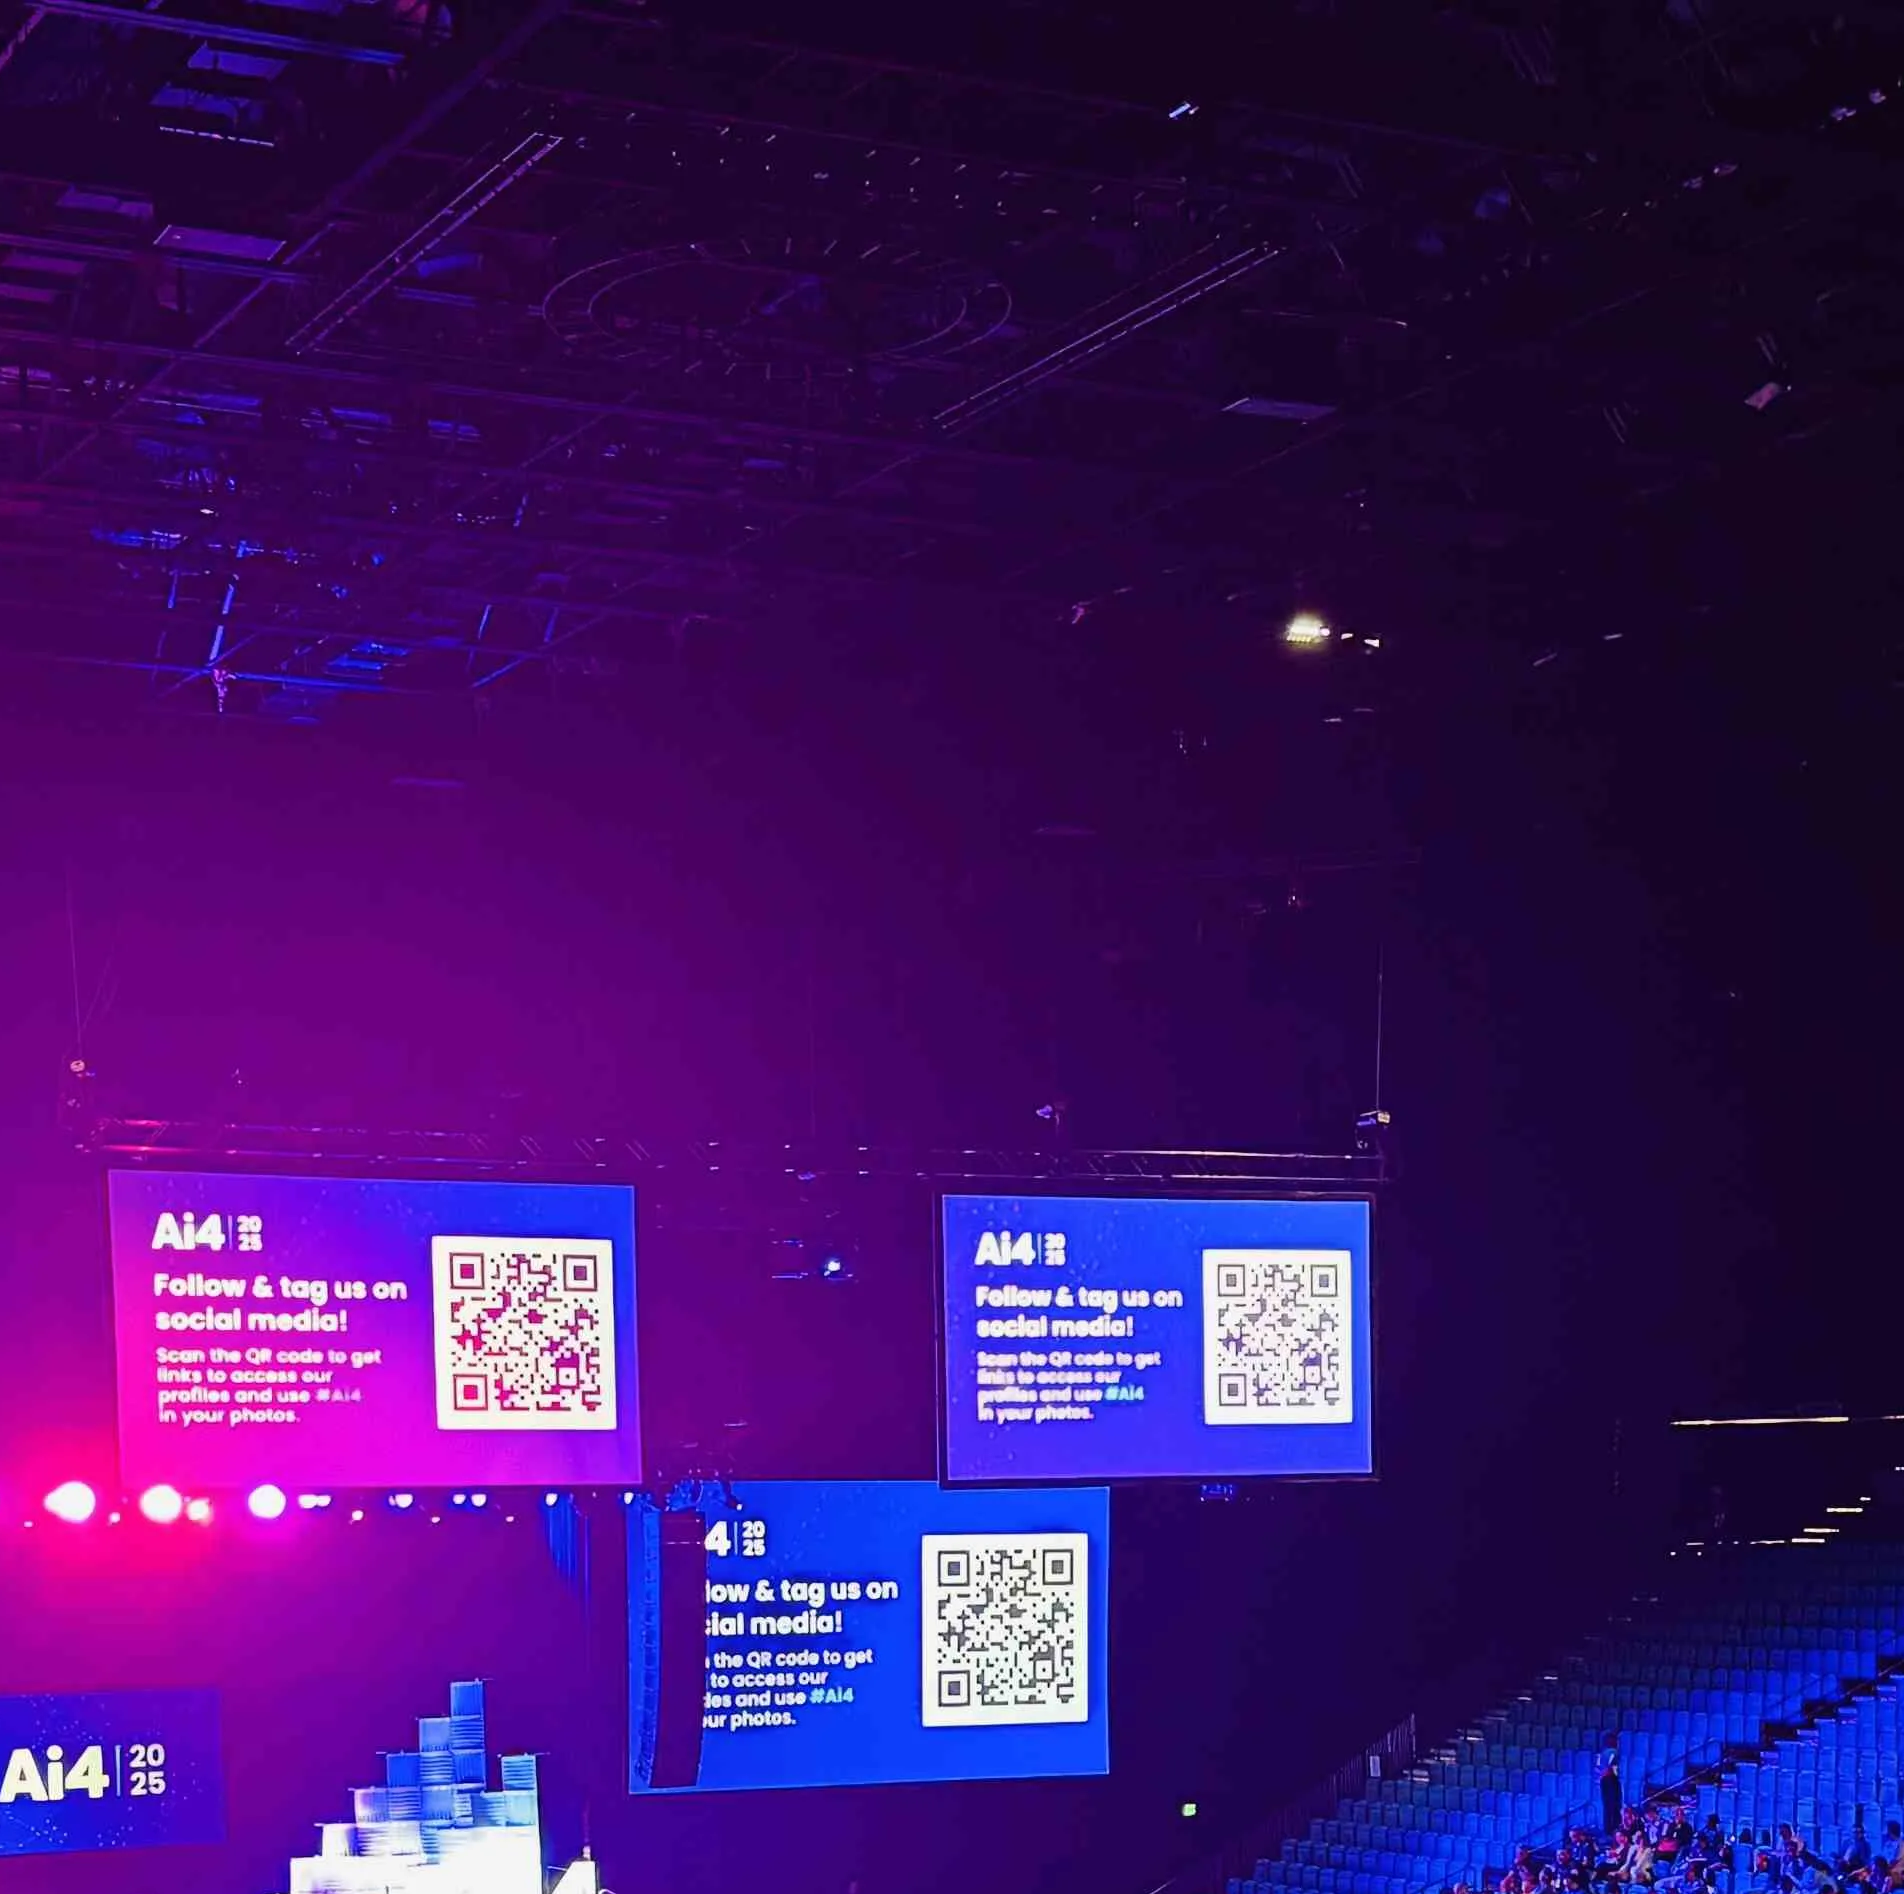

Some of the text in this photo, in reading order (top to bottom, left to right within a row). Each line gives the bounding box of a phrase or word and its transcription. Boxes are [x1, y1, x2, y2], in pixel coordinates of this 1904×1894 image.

[151, 1211, 225, 1251] Ai4
[237, 1215, 263, 1233] 20
[238, 1232, 263, 1251] 25
[974, 1231, 1036, 1266] Ai4
[153, 1273, 407, 1306] Follow & tag us on
[975, 1285, 1183, 1314] Follow & tag us on
[155, 1306, 347, 1332] social media!
[976, 1314, 1134, 1338] social media!
[156, 1347, 381, 1368] Scan the QR code to get
[157, 1367, 332, 1384] links to access our
[157, 1385, 231, 1405] profiles
[234, 1387, 273, 1404] and
[276, 1390, 311, 1403] use
[158, 1404, 301, 1427] in your photos.
[742, 1520, 766, 1538] 20
[742, 1538, 766, 1556] 25
[754, 1579, 776, 1602] &
[780, 1579, 826, 1608] tag
[830, 1582, 862, 1600] us
[865, 1581, 899, 1600] on
[750, 1609, 842, 1636] media!
[713, 1651, 744, 1669] the
[746, 1651, 772, 1670] QR
[775, 1649, 820, 1667] code
[822, 1650, 842, 1665] to
[844, 1648, 873, 1669] get
[710, 1671, 829, 1689] to access our
[735, 1689, 771, 1708] and
[774, 1691, 807, 1706] use
[809, 1687, 854, 1704] #Ai4
[730, 1710, 796, 1732] photos.
[128, 1743, 165, 1768] 20
[129, 1771, 166, 1796] 25
